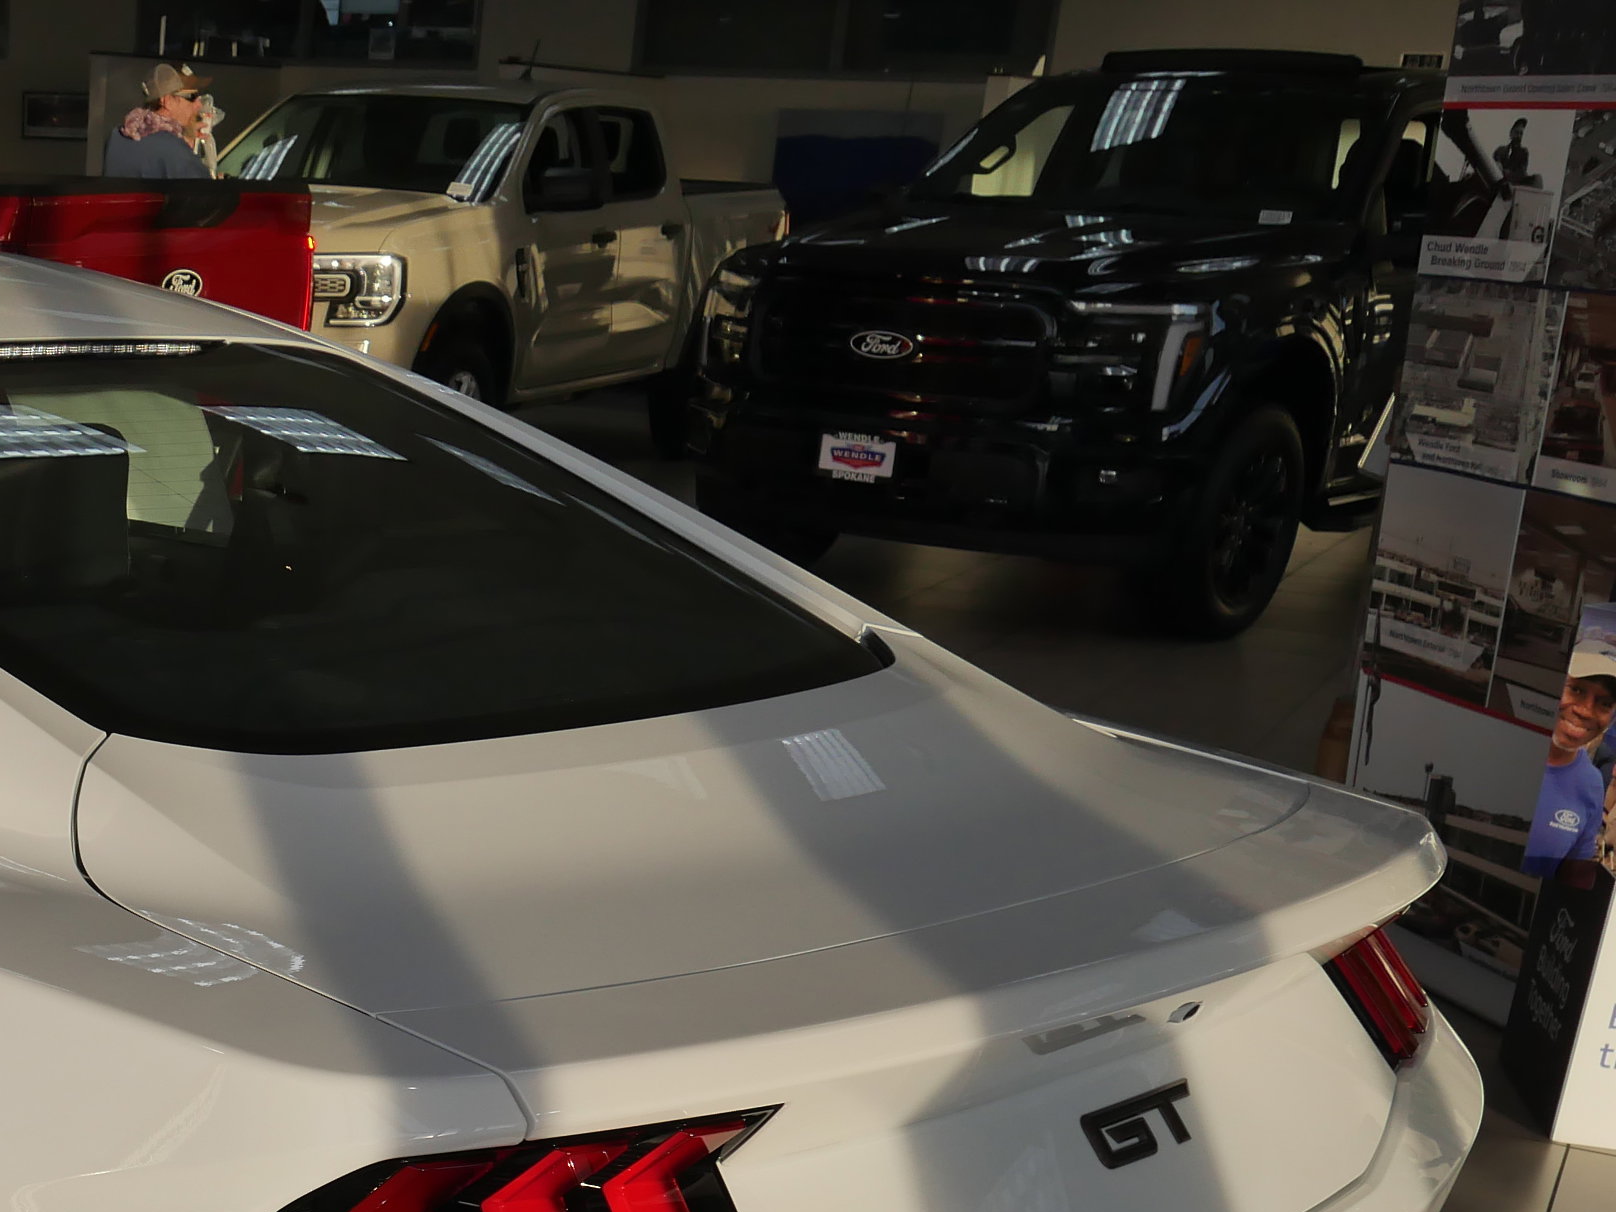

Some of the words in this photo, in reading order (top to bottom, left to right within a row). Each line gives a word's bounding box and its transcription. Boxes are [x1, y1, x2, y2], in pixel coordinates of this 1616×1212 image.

[1427, 241, 1452, 252] Chud
[1455, 243, 1488, 254] Wendle
[1430, 255, 1472, 270] Breaking
[1474, 259, 1505, 271] Ground
[860, 333, 902, 355] Ford
[838, 432, 881, 444] WENDLE
[833, 449, 881, 462] WENDLE
[832, 470, 876, 484] SPOKANE
[1549, 907, 1579, 964] Ford
[1536, 943, 1570, 1010] Building
[1527, 977, 1563, 1041] Together
[1079, 1077, 1192, 1170] GT
